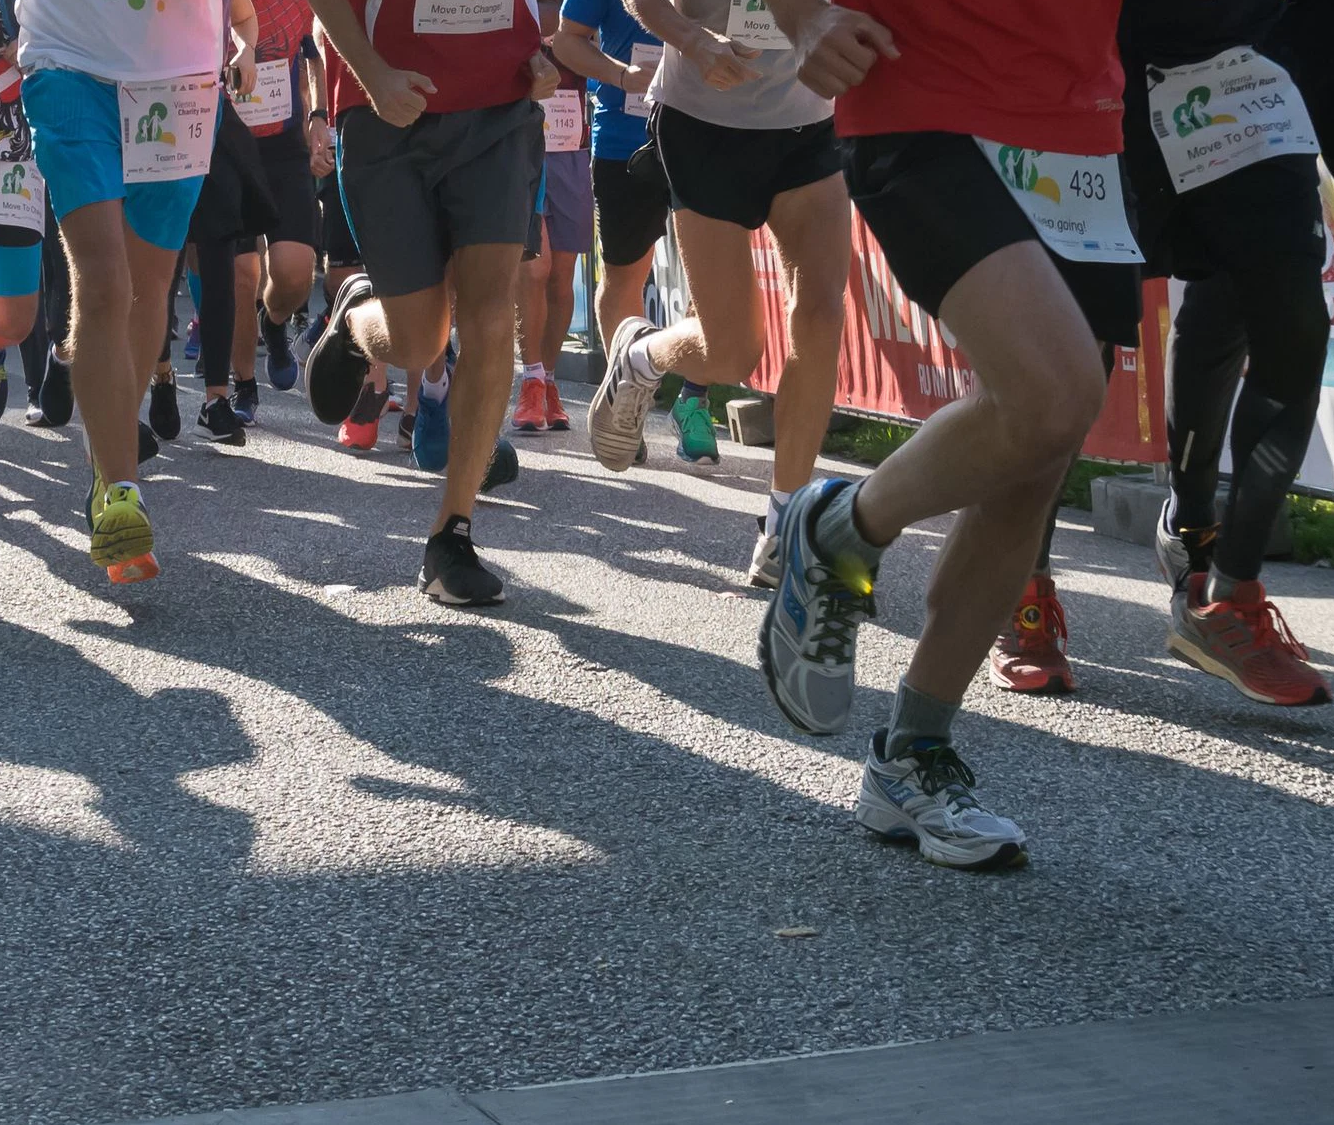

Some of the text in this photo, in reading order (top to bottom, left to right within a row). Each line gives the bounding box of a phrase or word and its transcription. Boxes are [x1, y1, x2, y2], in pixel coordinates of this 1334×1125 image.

[430, 4, 457, 15] Move
[459, 5, 471, 14] To
[744, 20, 770, 30] Move
[1219, 74, 1254, 89] Vienna
[1223, 76, 1278, 96] Charity Run
[269, 88, 282, 99] 44
[177, 107, 200, 116] Charity
[1239, 92, 1286, 115] 1154
[188, 122, 203, 139] 15
[554, 118, 574, 129] 1143
[1186, 139, 1223, 161] Move
[1224, 132, 1242, 146] To
[1244, 118, 1292, 139] Change!
[1069, 170, 1107, 201] 433
[1057, 218, 1088, 236] going!
